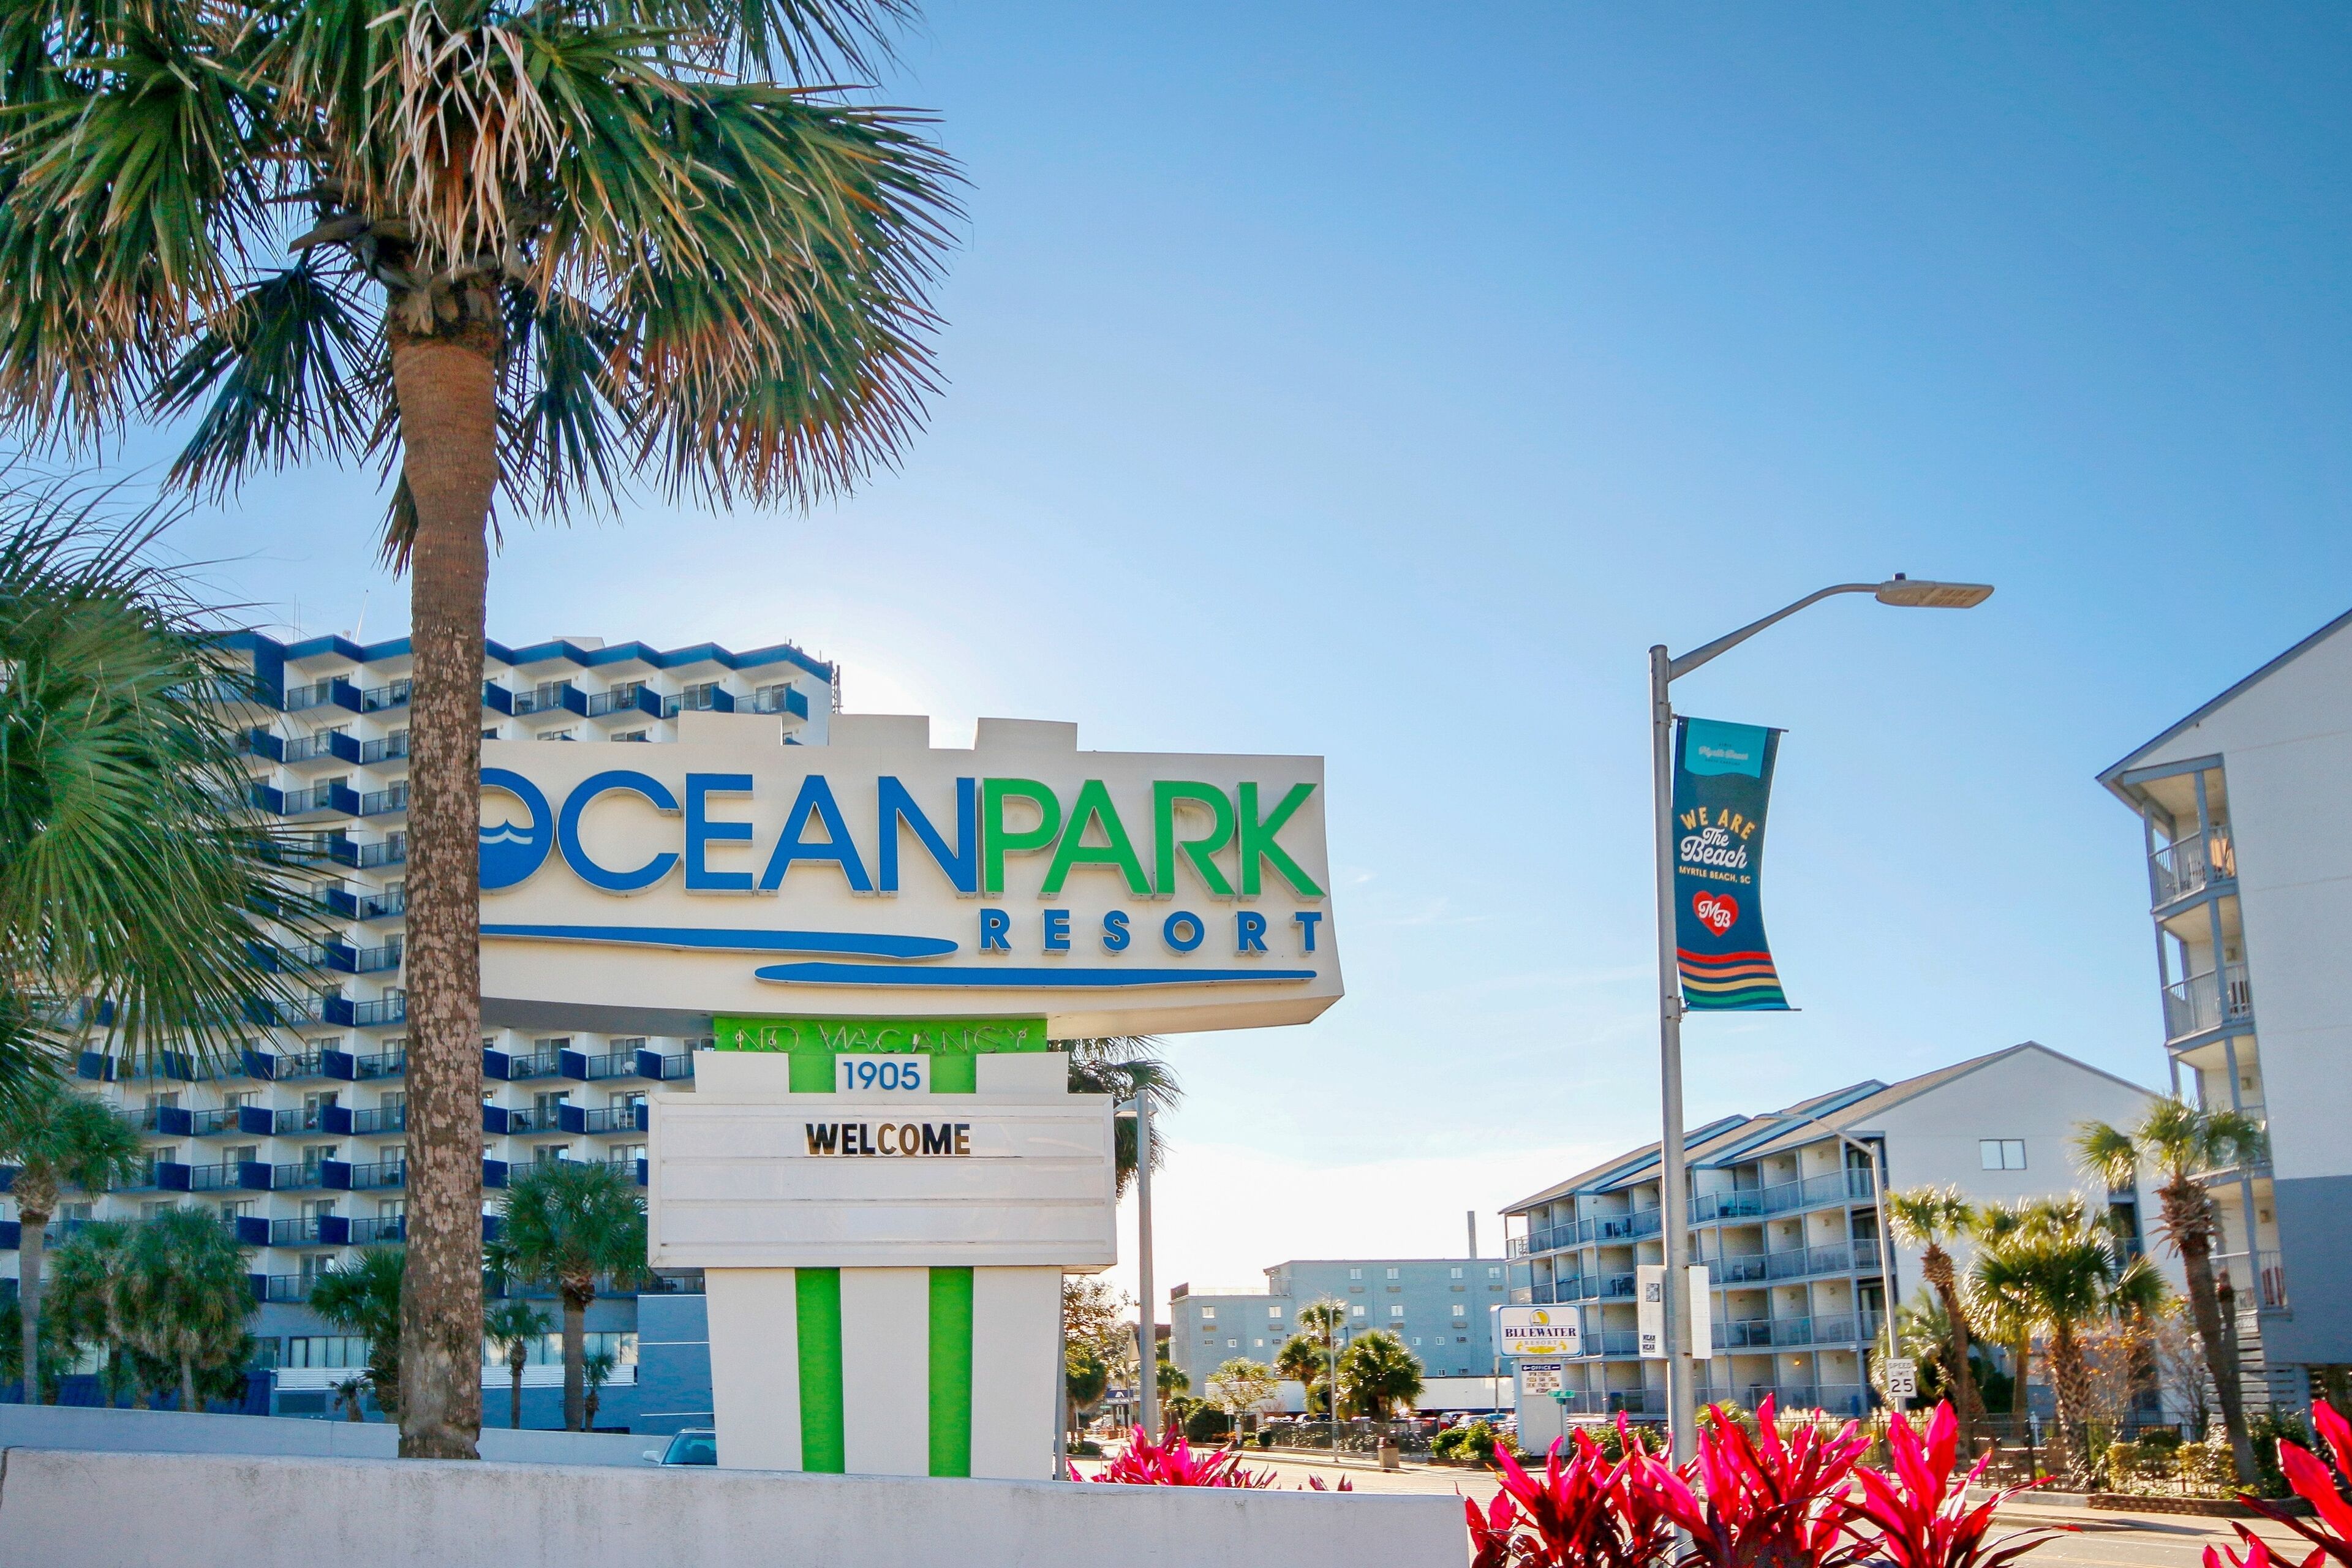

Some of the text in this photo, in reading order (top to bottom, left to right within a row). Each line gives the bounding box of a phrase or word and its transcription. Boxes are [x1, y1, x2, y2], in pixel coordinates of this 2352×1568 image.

[1680, 806, 1756, 840] WE ARE
[1702, 827, 1729, 846] The
[1681, 835, 1748, 869] Beach
[1679, 865, 1708, 878] MYRTLE
[1740, 875, 1751, 884] SC
[1698, 900, 1731, 928] MB
[979, 908, 1322, 956] RESORT
[735, 1025, 799, 1052] NO
[843, 1061, 921, 1091] 1905
[805, 1123, 971, 1155] WELCOME
[1505, 1327, 1577, 1337] BLUEWATER
[1891, 1379, 1913, 1392] 25
